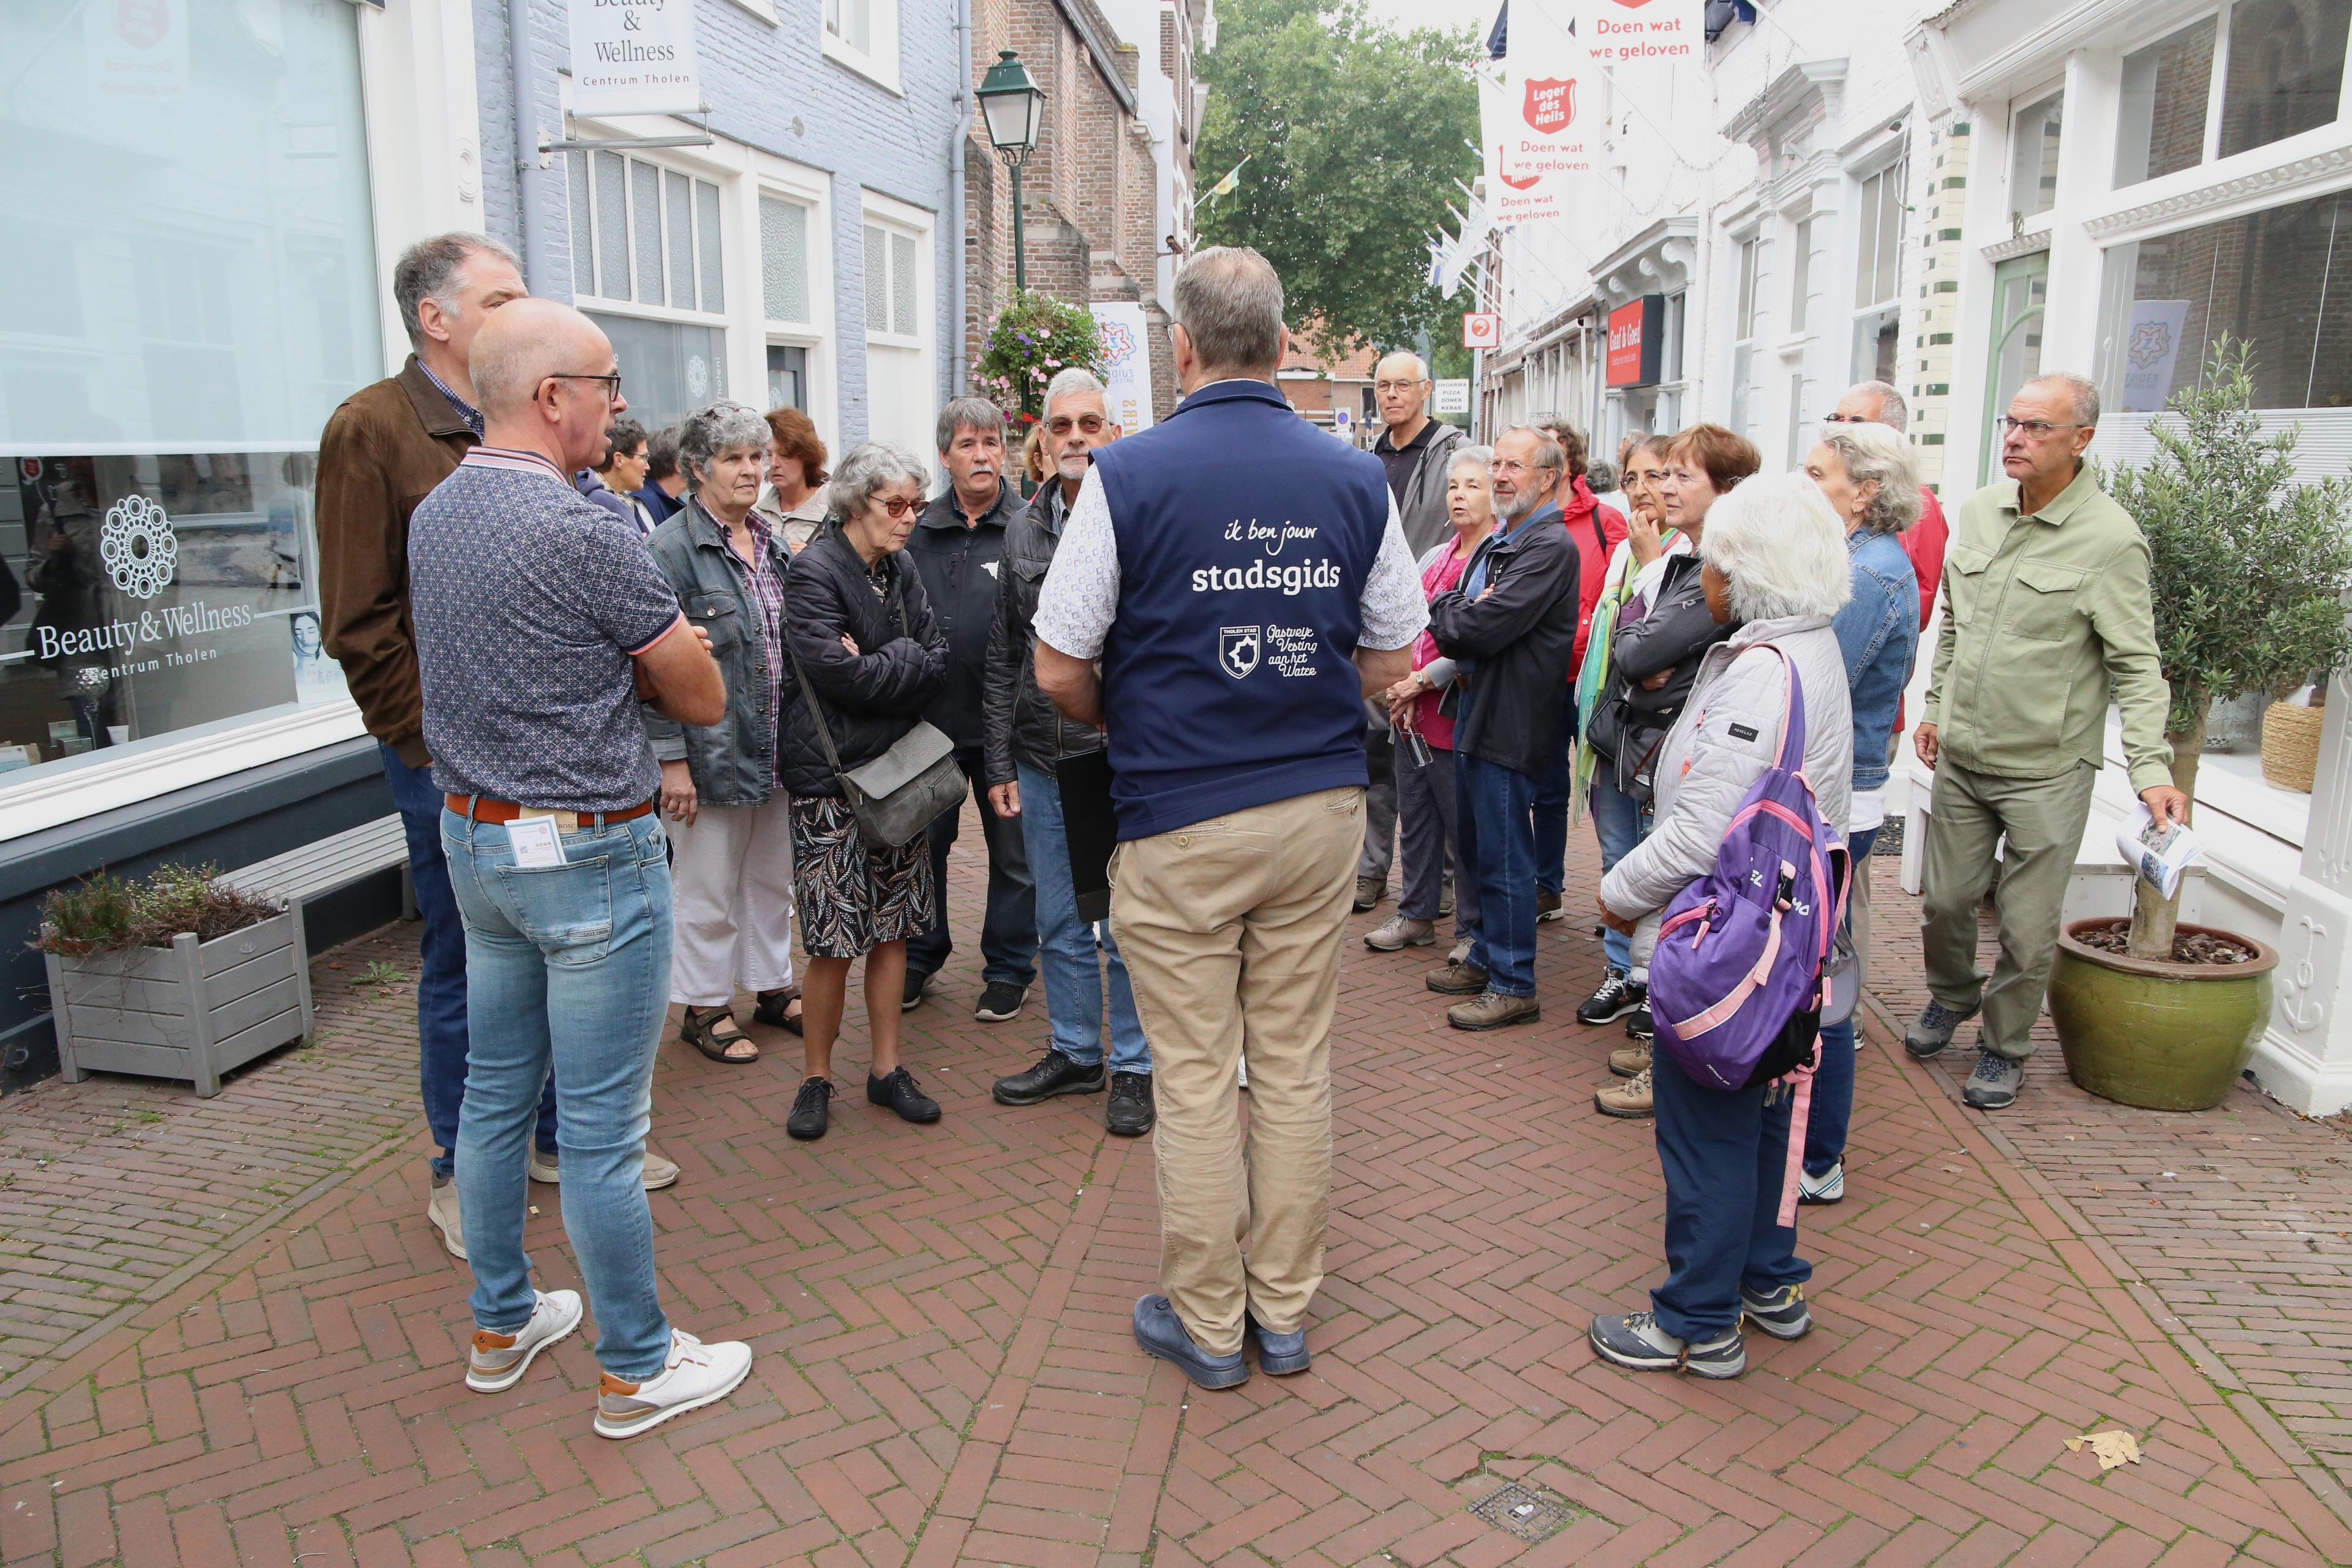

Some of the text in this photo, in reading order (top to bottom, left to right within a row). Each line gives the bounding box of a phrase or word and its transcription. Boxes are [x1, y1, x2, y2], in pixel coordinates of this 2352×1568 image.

[624, 10, 641, 31] &
[1597, 18, 1681, 34] Doen wat
[594, 39, 674, 62] Wellness
[1589, 42, 1689, 61] we geloven
[583, 74, 689, 86] Centrum Tholen
[1533, 86, 1567, 101] Leger
[1539, 100, 1560, 112] des
[1536, 110, 1565, 126] Heils
[1521, 141, 1583, 153] Doen wat
[1536, 159, 1588, 172] geloven
[1501, 195, 1553, 206] Doen wat
[1516, 210, 1559, 222] geloven
[1627, 318, 1641, 346] Goed
[1224, 518, 1318, 556] ik ben jouw
[1192, 558, 1341, 596] stadsgids
[1267, 624, 1314, 643] Gastvrije
[1276, 638, 1318, 654] Vesting
[165, 646, 217, 667] Tholen
[1268, 652, 1308, 665] aan het
[1278, 663, 1316, 677] Water
